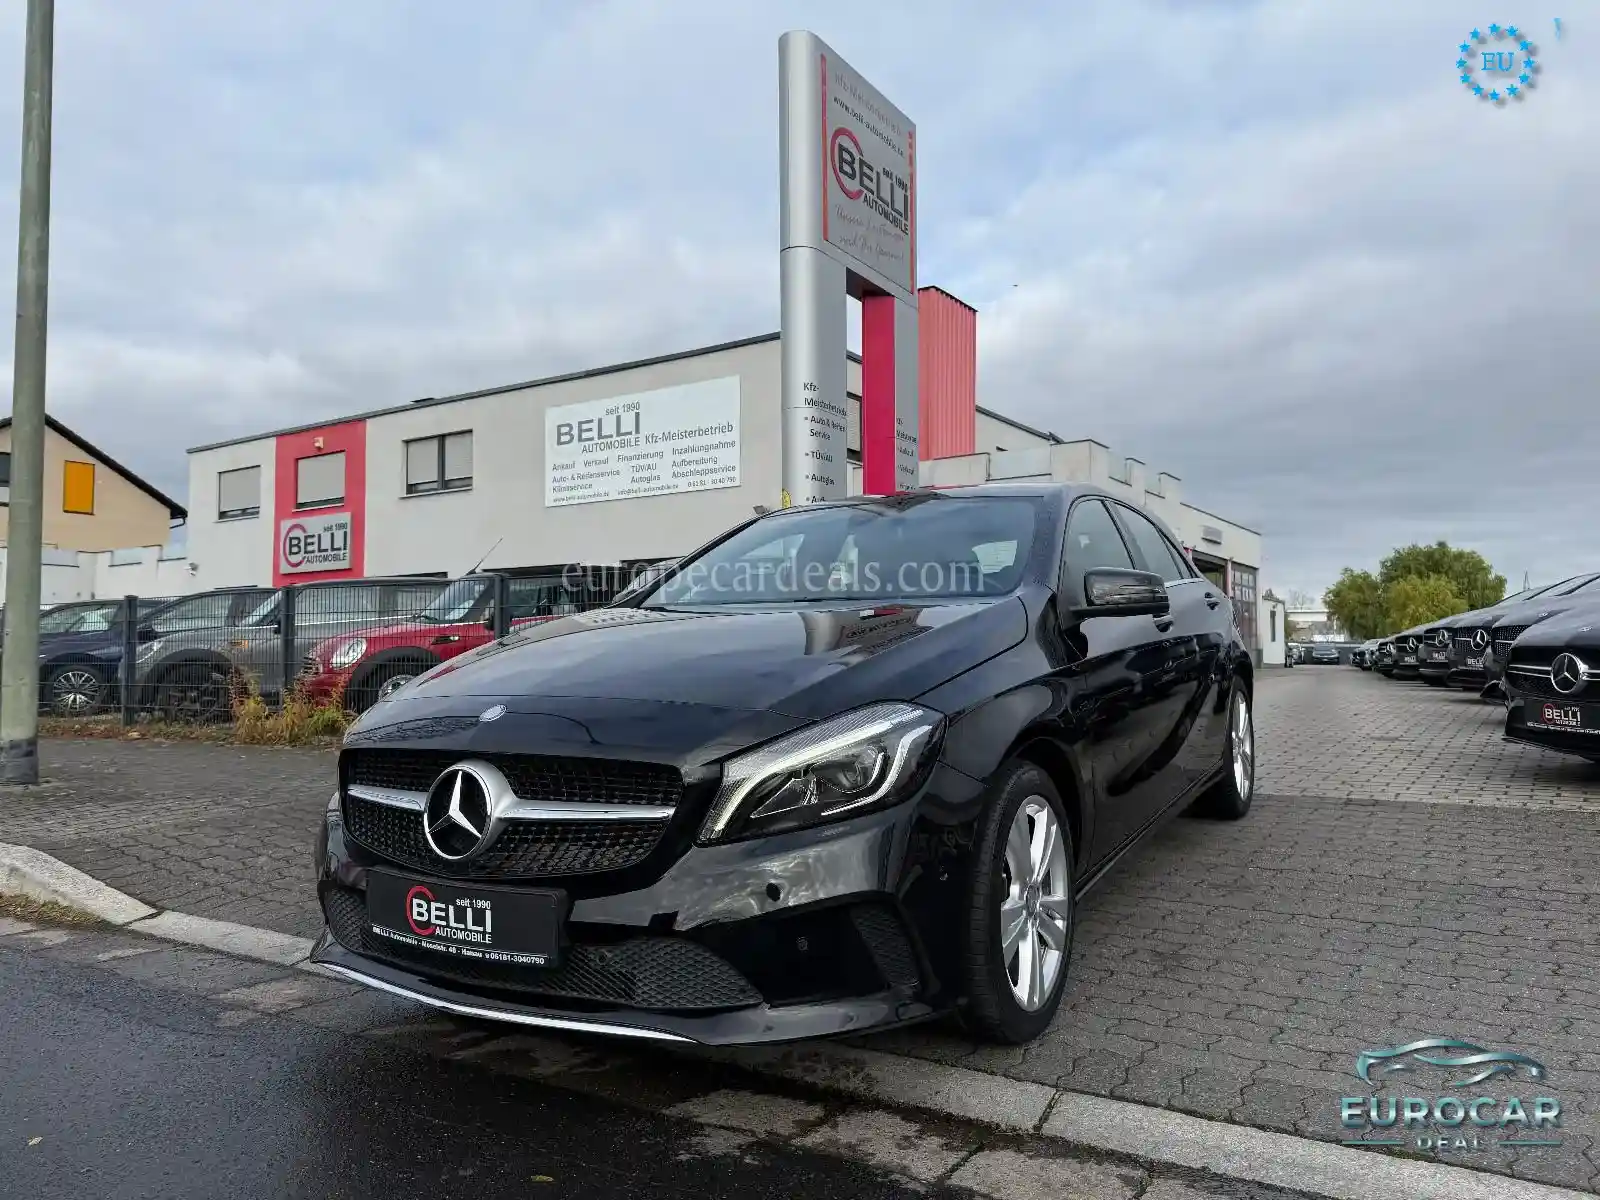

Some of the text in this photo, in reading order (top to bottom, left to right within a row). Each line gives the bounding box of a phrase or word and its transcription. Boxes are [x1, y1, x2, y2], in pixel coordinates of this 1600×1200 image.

[838, 141, 909, 222] BELLI
[895, 174, 908, 192] 1990
[863, 193, 909, 236] AUTOMOBILE
[804, 382, 819, 393] Kfz-
[605, 401, 640, 416] seit 1990
[556, 411, 640, 446] BELLI
[645, 422, 734, 445] Kfz-Meisterbetrieb
[810, 428, 831, 440] Service
[582, 437, 640, 454] AUTOMOBILE
[617, 450, 664, 463] Finanzierung
[672, 439, 736, 456] Inzahlungnahme
[671, 456, 718, 468] Aufbereitung
[631, 474, 661, 484] Autoglas
[671, 464, 736, 479] Abschleppservice
[288, 531, 348, 555] BELLI
[305, 553, 347, 565] AUTOMOBILE
[1544, 708, 1581, 722] BELLI
[455, 897, 491, 910] seit 1990
[412, 898, 492, 933] BELLI
[435, 926, 492, 944] AUTOMOBILE
[372, 926, 389, 937] BELLI
[490, 952, 545, 965] 06181-3040790
